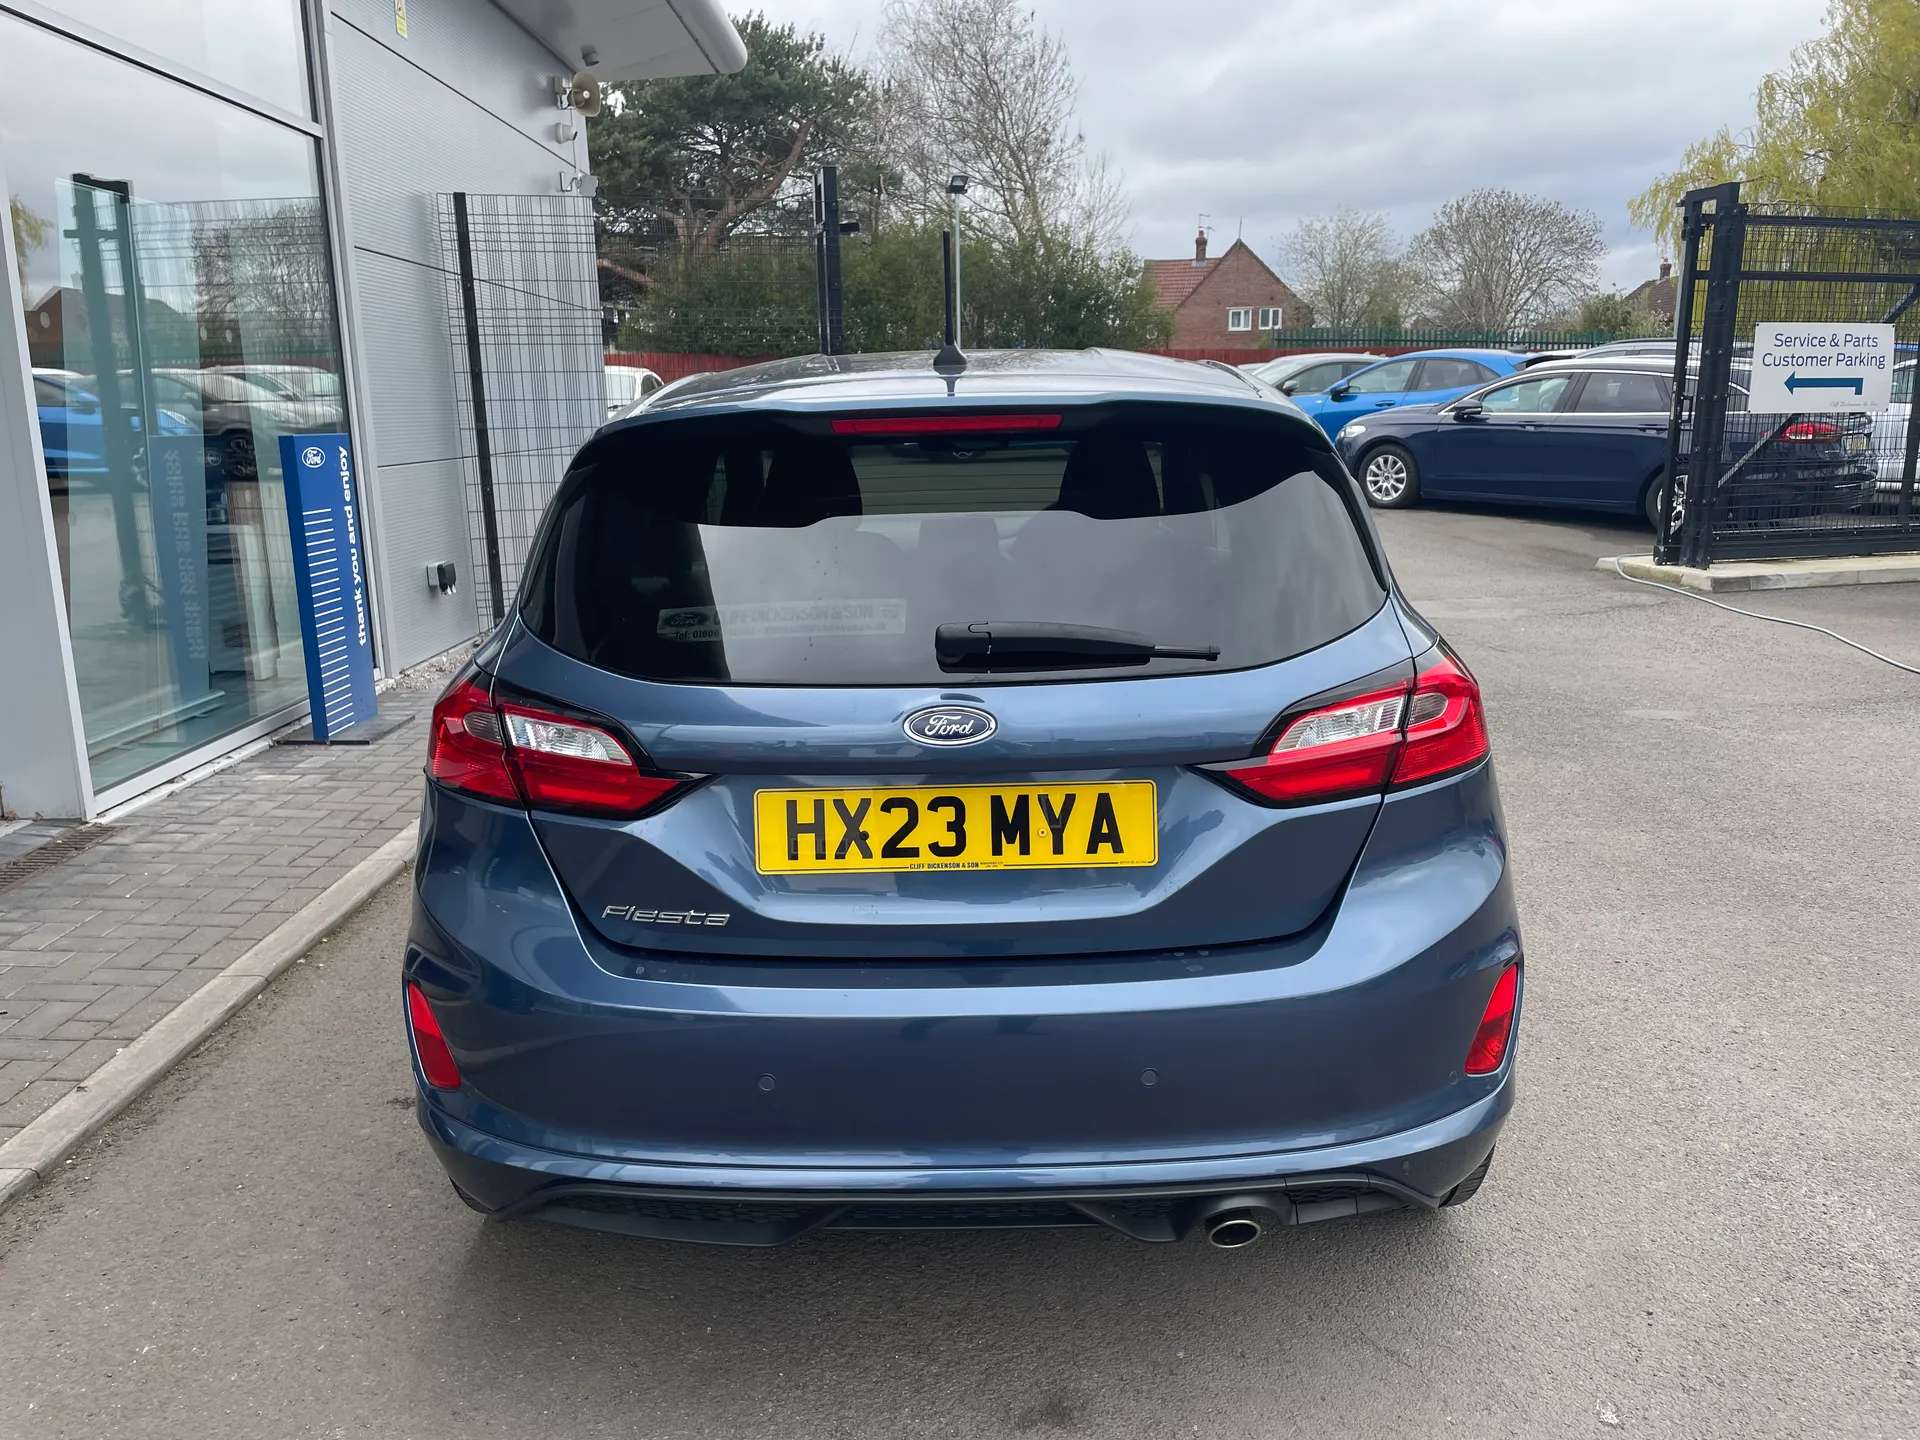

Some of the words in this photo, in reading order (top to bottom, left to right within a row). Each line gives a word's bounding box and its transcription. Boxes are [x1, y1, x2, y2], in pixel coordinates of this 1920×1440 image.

[1774, 333, 1826, 348] Service
[1829, 333, 1840, 347] &
[1844, 333, 1878, 348] Parts
[1762, 353, 1832, 367] Customer
[1836, 352, 1885, 369] Parking
[339, 446, 350, 502] enjoy
[344, 506, 355, 545] and
[350, 548, 361, 587] you
[354, 588, 367, 646] thank
[925, 715, 974, 735] Ford
[786, 795, 967, 860] HX23
[991, 792, 1124, 856] MYA
[601, 905, 730, 926] Fiesta
